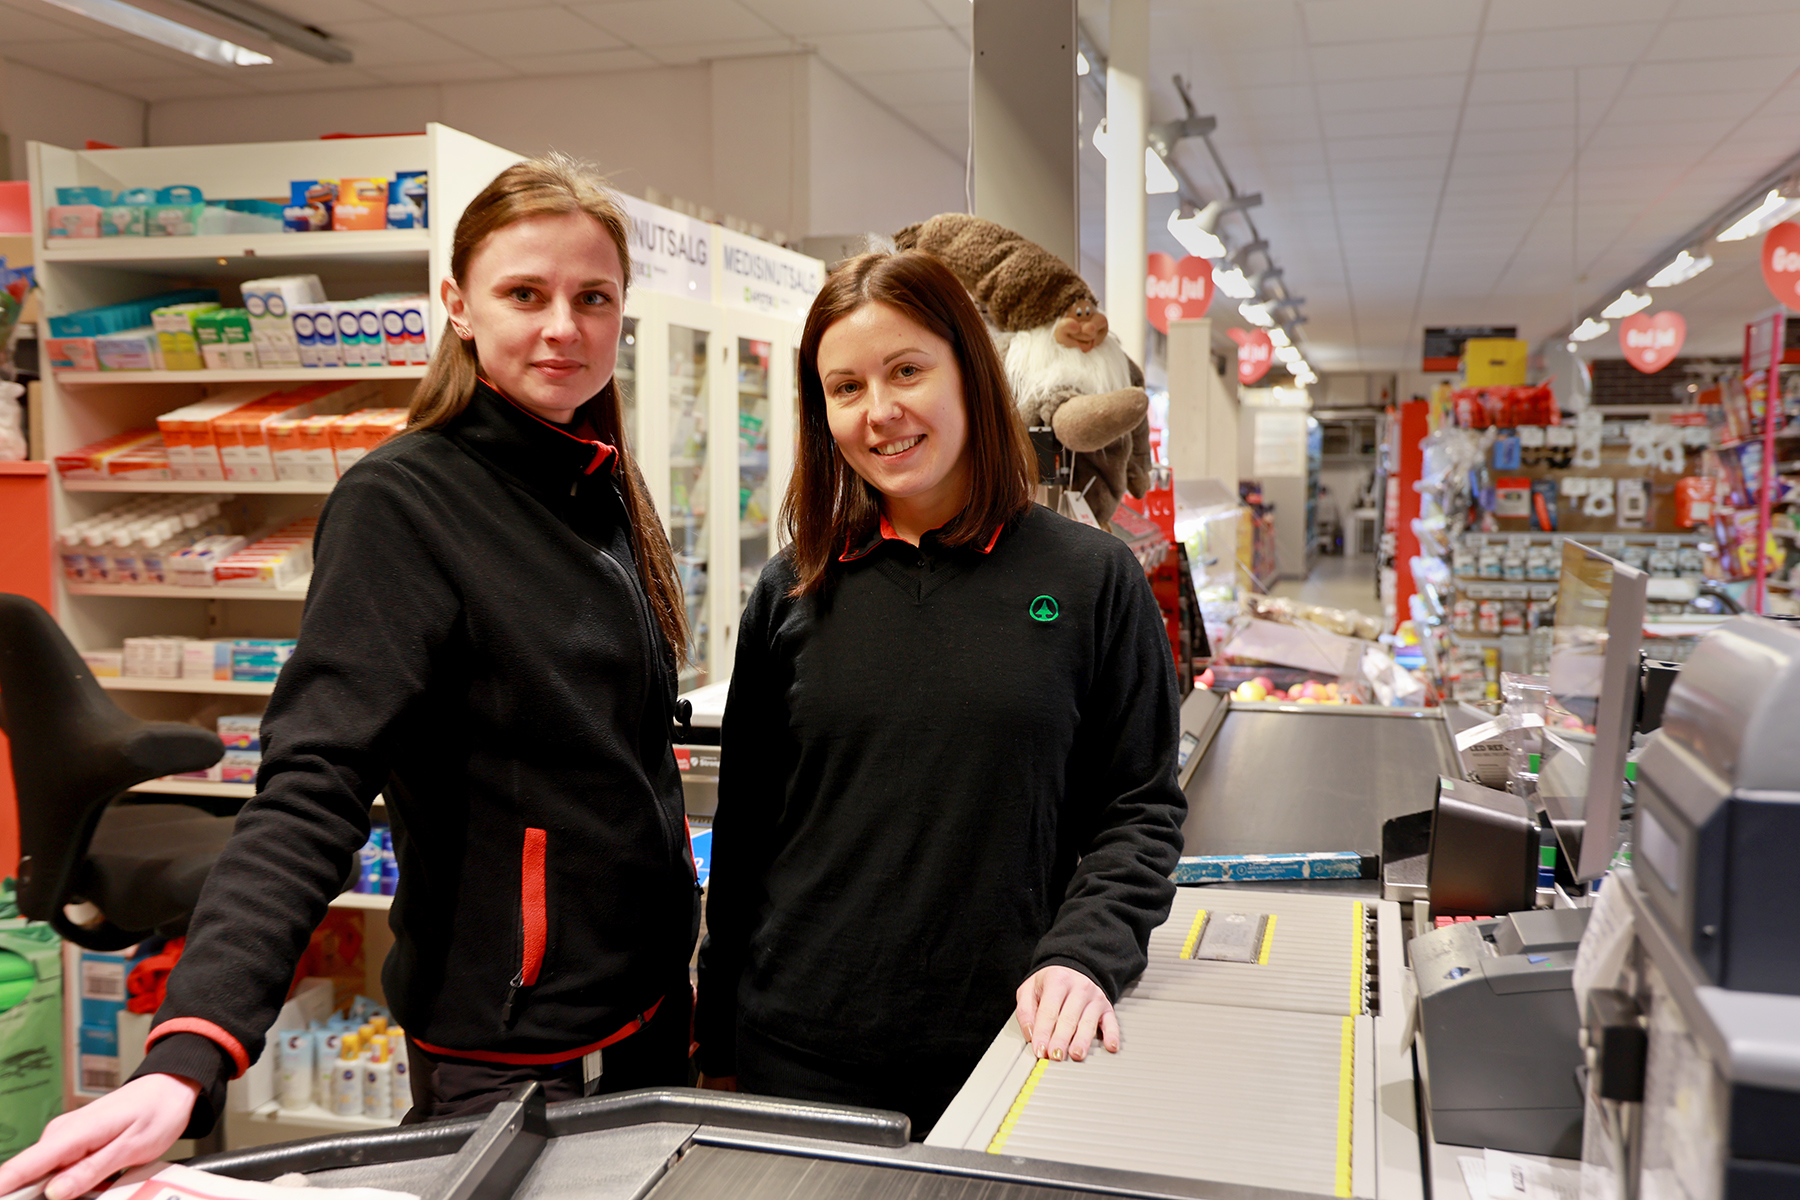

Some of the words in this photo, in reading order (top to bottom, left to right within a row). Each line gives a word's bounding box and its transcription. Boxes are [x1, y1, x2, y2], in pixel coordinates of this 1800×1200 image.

[632, 217, 707, 266] NUTSALG
[723, 243, 817, 296] MEDISNUTSALG
[1238, 342, 1250, 361] od
